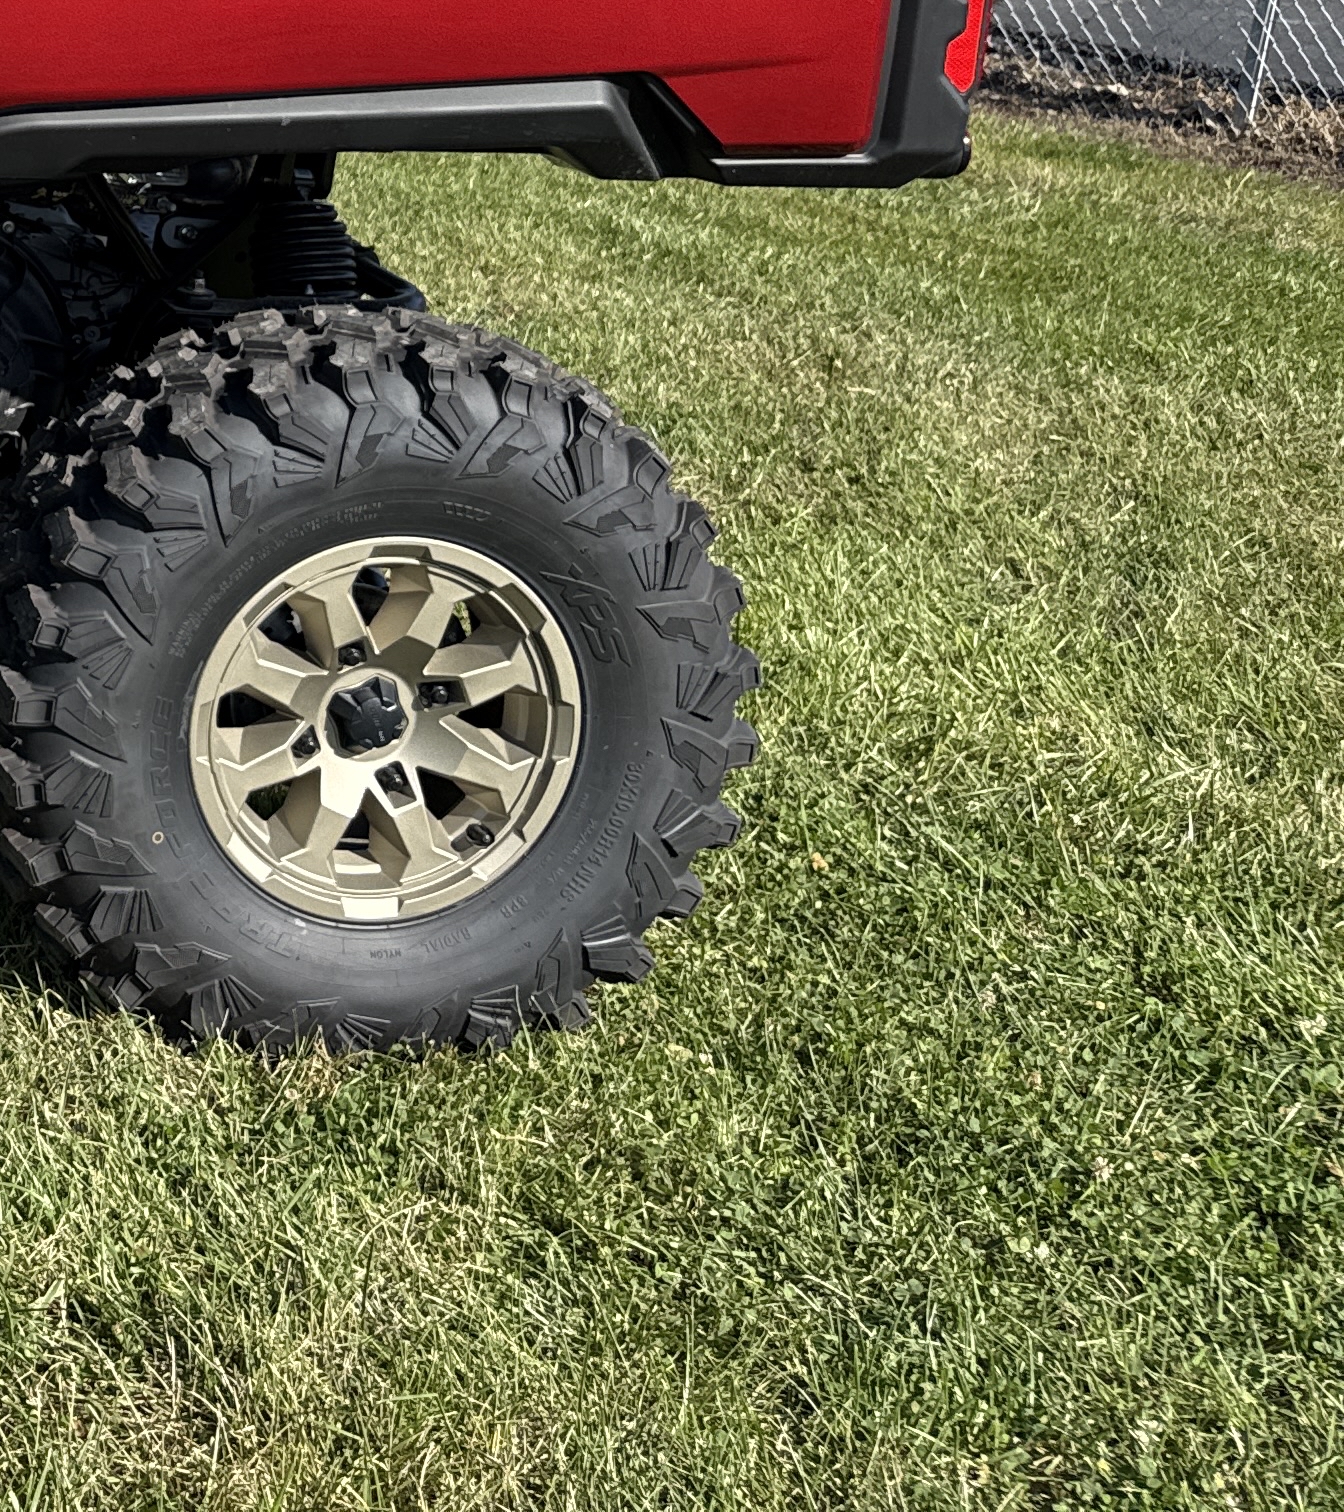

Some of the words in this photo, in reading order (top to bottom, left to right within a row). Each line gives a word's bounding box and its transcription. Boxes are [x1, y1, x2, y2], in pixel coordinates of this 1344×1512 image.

[541, 563, 632, 668] XPS
[149, 695, 200, 859] FORCE
[588, 761, 644, 867] 30X10.00R14
[560, 864, 597, 902] NHS
[369, 950, 401, 959] NYLON
[420, 926, 472, 954] RADIAL
